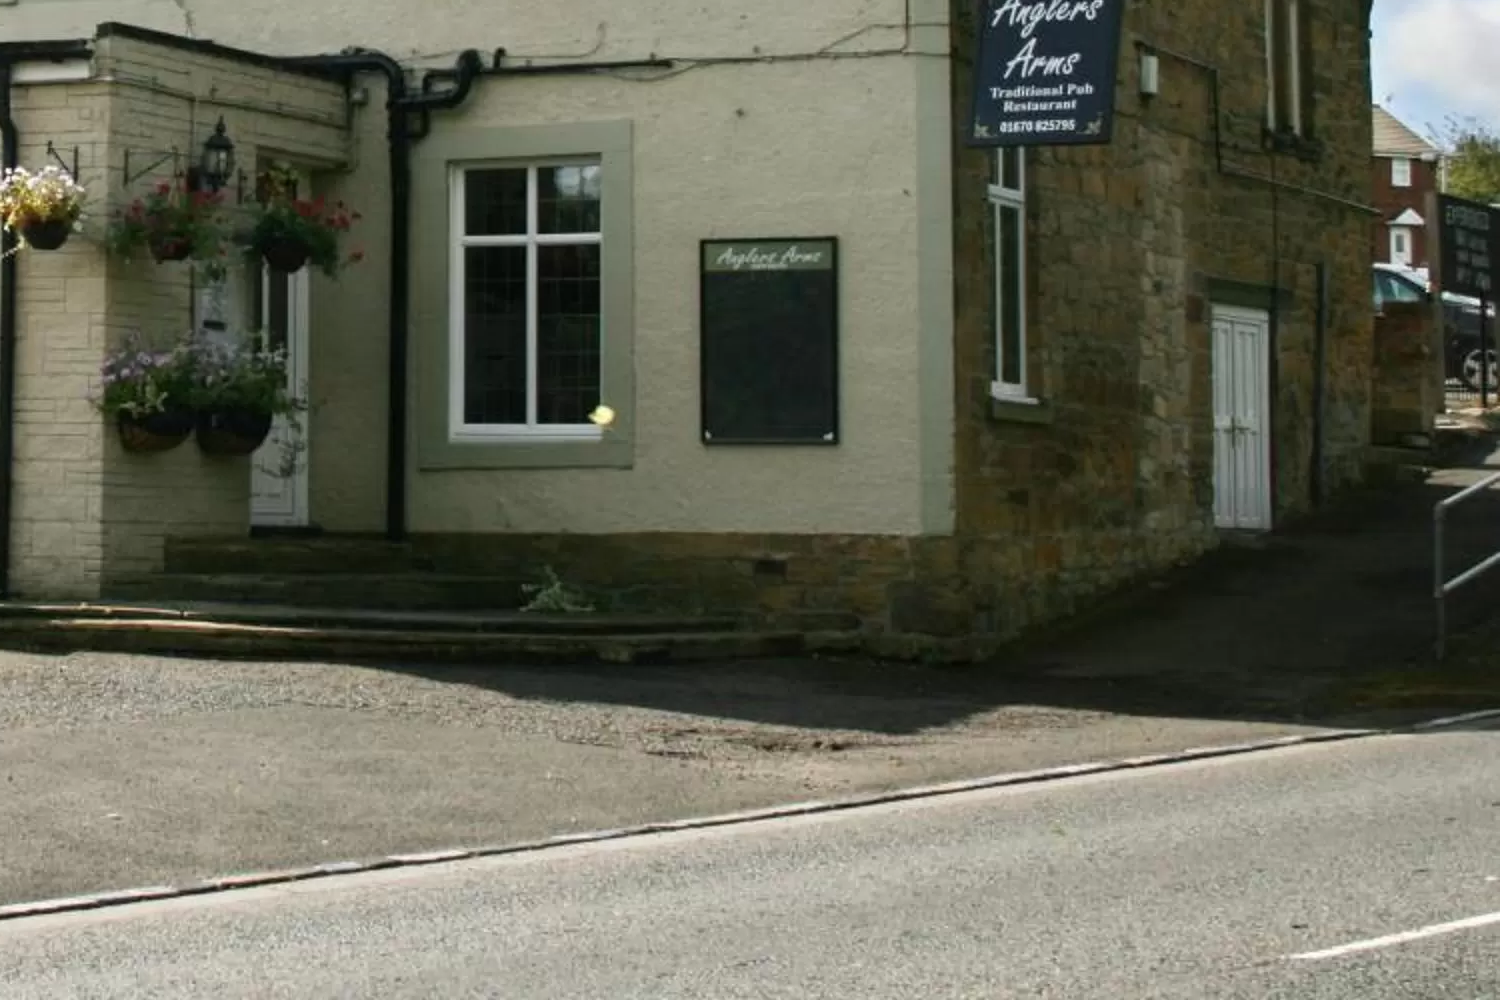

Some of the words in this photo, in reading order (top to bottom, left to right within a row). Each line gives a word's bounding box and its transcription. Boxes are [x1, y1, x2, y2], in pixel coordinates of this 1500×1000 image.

[1003, 37, 1082, 79] Arms
[989, 83, 1063, 99] Traditional
[1067, 82, 1094, 96] Pub
[1003, 99, 1077, 113] Restaurant
[780, 245, 822, 265] Arms
